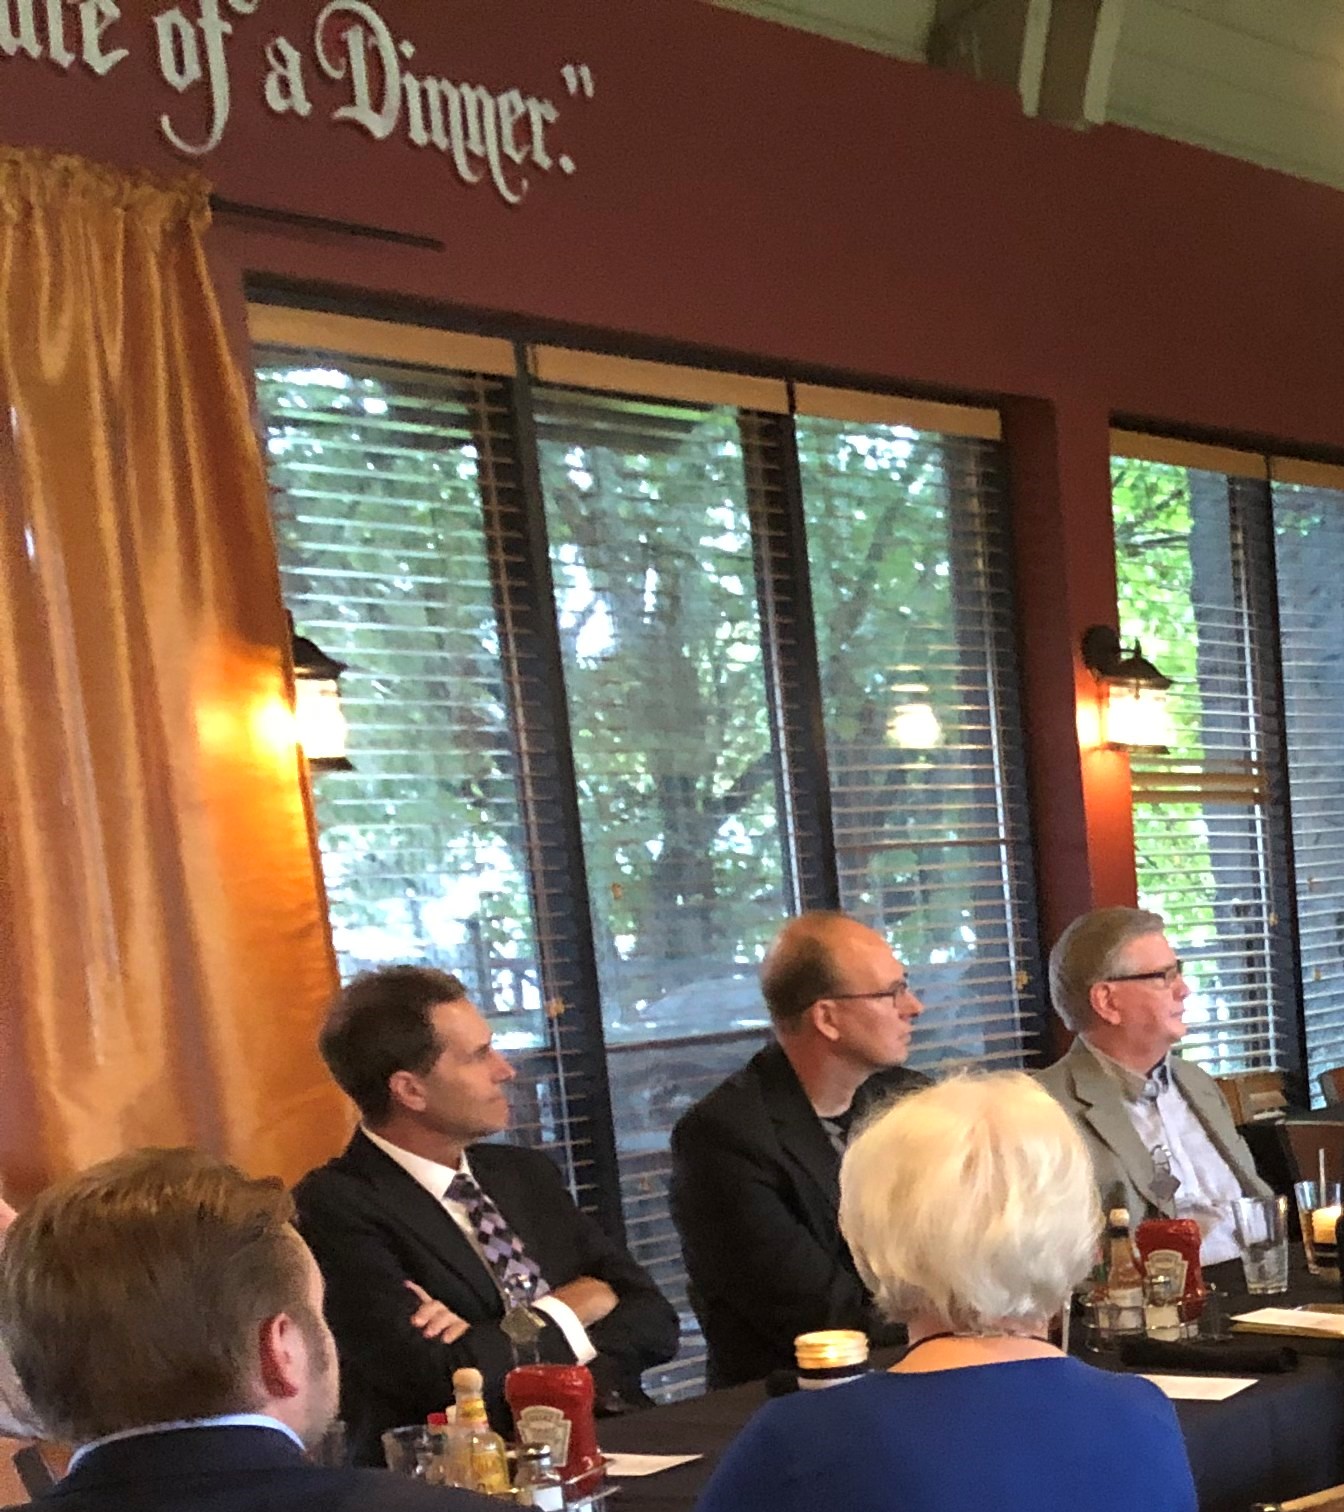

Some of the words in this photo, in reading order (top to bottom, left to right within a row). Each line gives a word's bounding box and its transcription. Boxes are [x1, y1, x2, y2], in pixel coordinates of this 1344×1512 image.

[152, 0, 258, 155] of
[264, 36, 312, 117] a
[315, 0, 594, 204] Dinner."
